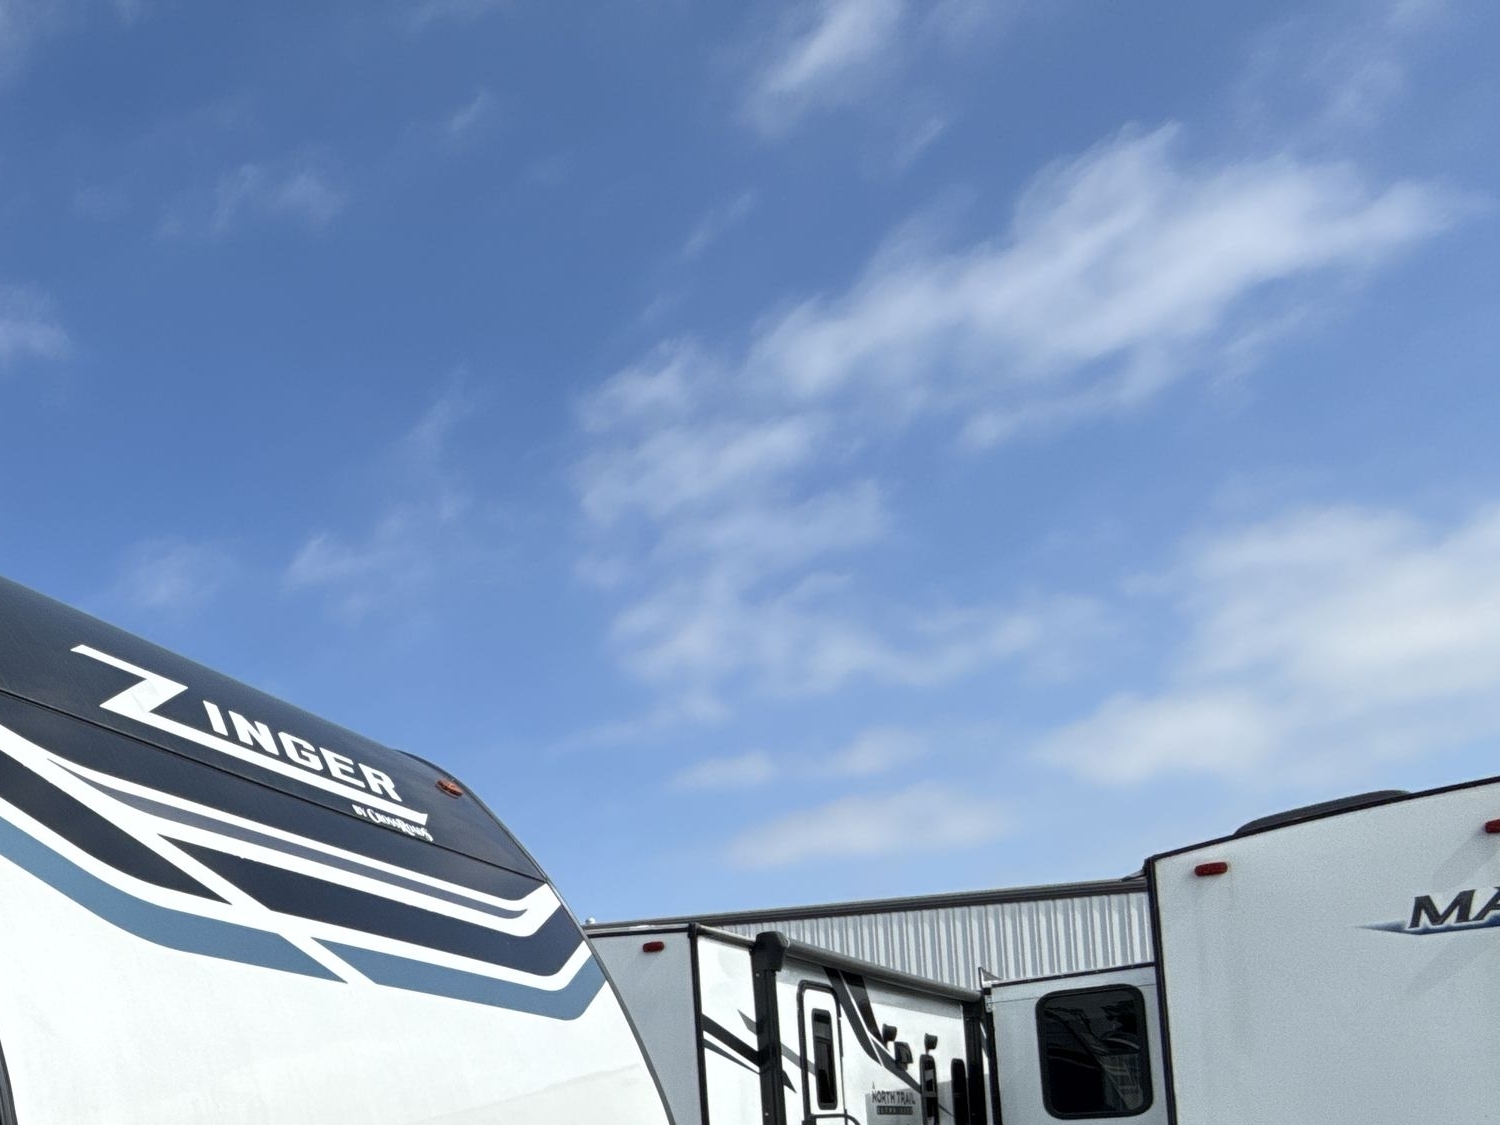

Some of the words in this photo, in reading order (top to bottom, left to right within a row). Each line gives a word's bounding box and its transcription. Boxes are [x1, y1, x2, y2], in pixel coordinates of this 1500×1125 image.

[70, 644, 428, 826] ZINGER
[871, 1089, 896, 1104] NORTH
[896, 1090, 916, 1105] TRAIL
